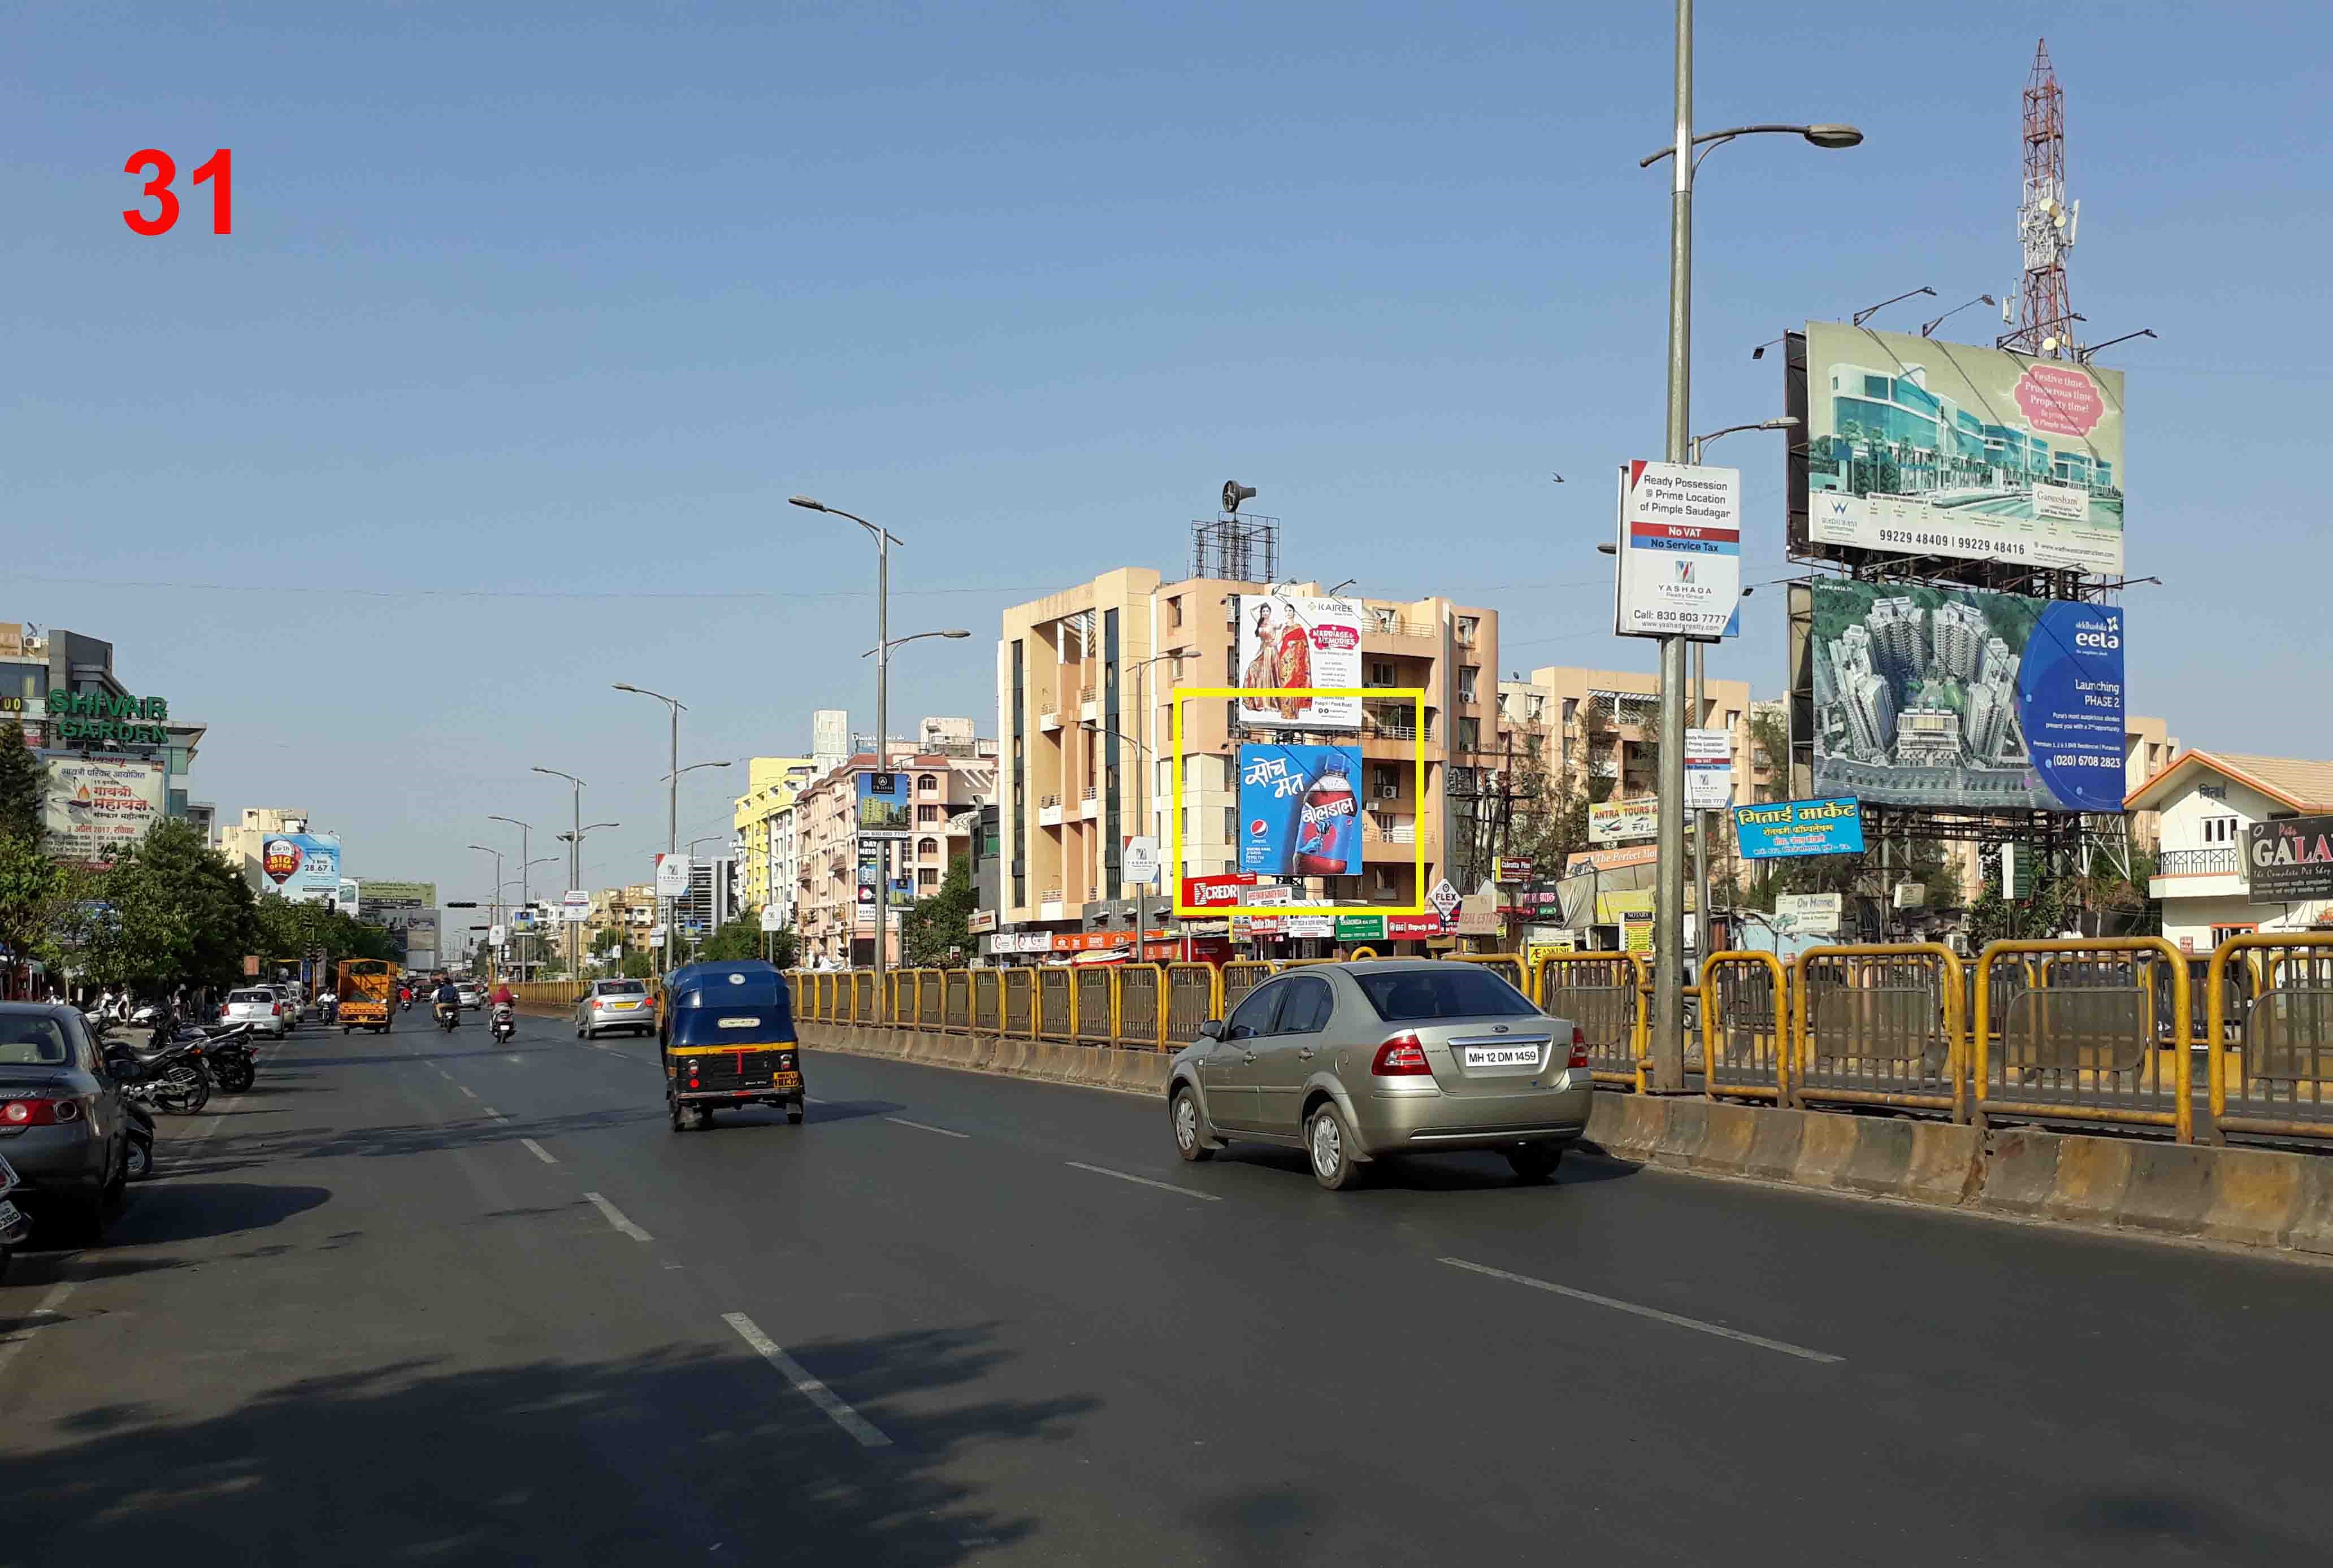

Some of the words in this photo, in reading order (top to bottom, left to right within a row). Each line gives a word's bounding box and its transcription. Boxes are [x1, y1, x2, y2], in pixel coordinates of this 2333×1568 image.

[1644, 475, 1672, 488] Ready
[1676, 477, 1728, 490] Possession
[1656, 489, 1683, 501] Prime
[1686, 492, 1726, 504] Location
[1640, 502, 1649, 511] of
[1652, 503, 1682, 515] Pimple
[1686, 505, 1731, 519] Saudagar
[1668, 527, 1682, 536] No
[1683, 528, 1702, 537] VAT
[1651, 538, 1664, 548] No
[1666, 540, 1701, 551] Service
[1703, 542, 1719, 552] Tax
[1879, 529, 1912, 543] 99229
[1915, 533, 1948, 546] 48409
[1958, 537, 1991, 550] 99229
[1993, 542, 2024, 554] 48416
[1658, 584, 1712, 594] YASHADA
[1319, 602, 1352, 612] KAIREE
[1634, 610, 1654, 619] Call:
[1657, 611, 1676, 620] 830
[1679, 613, 1698, 622] 803
[1702, 614, 1727, 624] 7777
[2075, 632, 2119, 649] eela
[2075, 679, 2120, 695] Launching
[49, 688, 168, 719] SHIVAR
[2084, 695, 2113, 707] PHASE
[2114, 697, 2120, 707] 2
[60, 718, 168, 742] GARDEN
[2053, 754, 2076, 767] (020)
[2078, 755, 2098, 767] 6708
[2100, 758, 2120, 768] 2823
[1243, 758, 1287, 788] सोच
[93, 786, 132, 797] गायत्री
[1272, 774, 1304, 798] मत
[93, 798, 149, 811] महायज्ञ
[1302, 797, 1355, 823] बोलडाल
[1594, 809, 1620, 820] ANTRA
[1623, 806, 1649, 817] TOURS
[1738, 805, 1793, 826] गिताई
[1797, 802, 1855, 820] मार्केट
[1595, 853, 1610, 863] The
[1614, 849, 1641, 861] Perfect
[1469, 1053, 1484, 1063] MH
[1486, 1052, 1496, 1062] 12
[1498, 1052, 1513, 1062] DM
[1515, 1051, 1536, 1061] 1459
